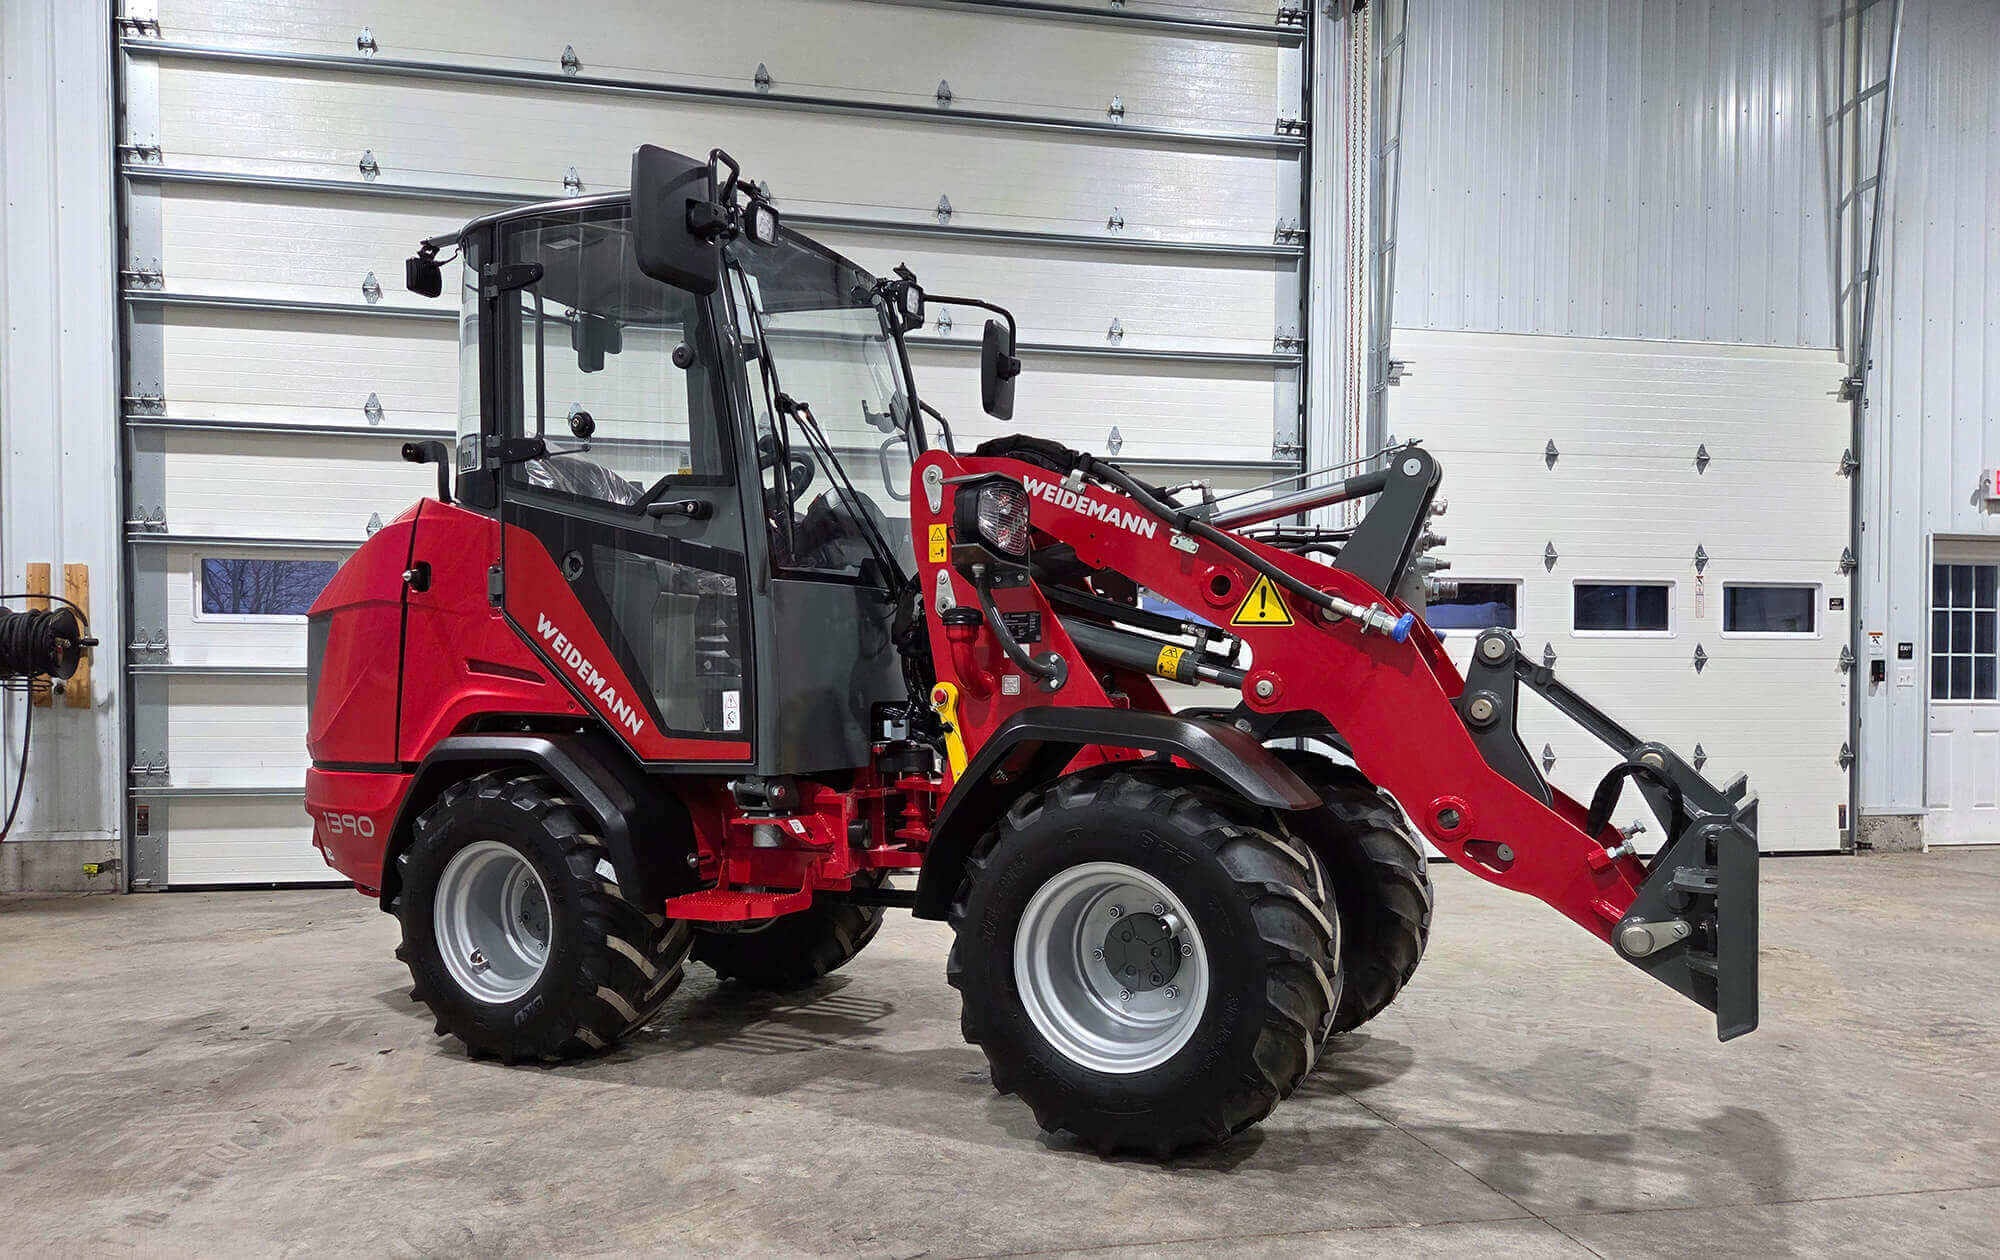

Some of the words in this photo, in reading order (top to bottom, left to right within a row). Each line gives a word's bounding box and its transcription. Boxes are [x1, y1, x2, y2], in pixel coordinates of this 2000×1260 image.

[1023, 475, 1158, 539] WEIDEMANN
[537, 612, 644, 736] WEIDEMANN
[323, 811, 375, 837] 1390
